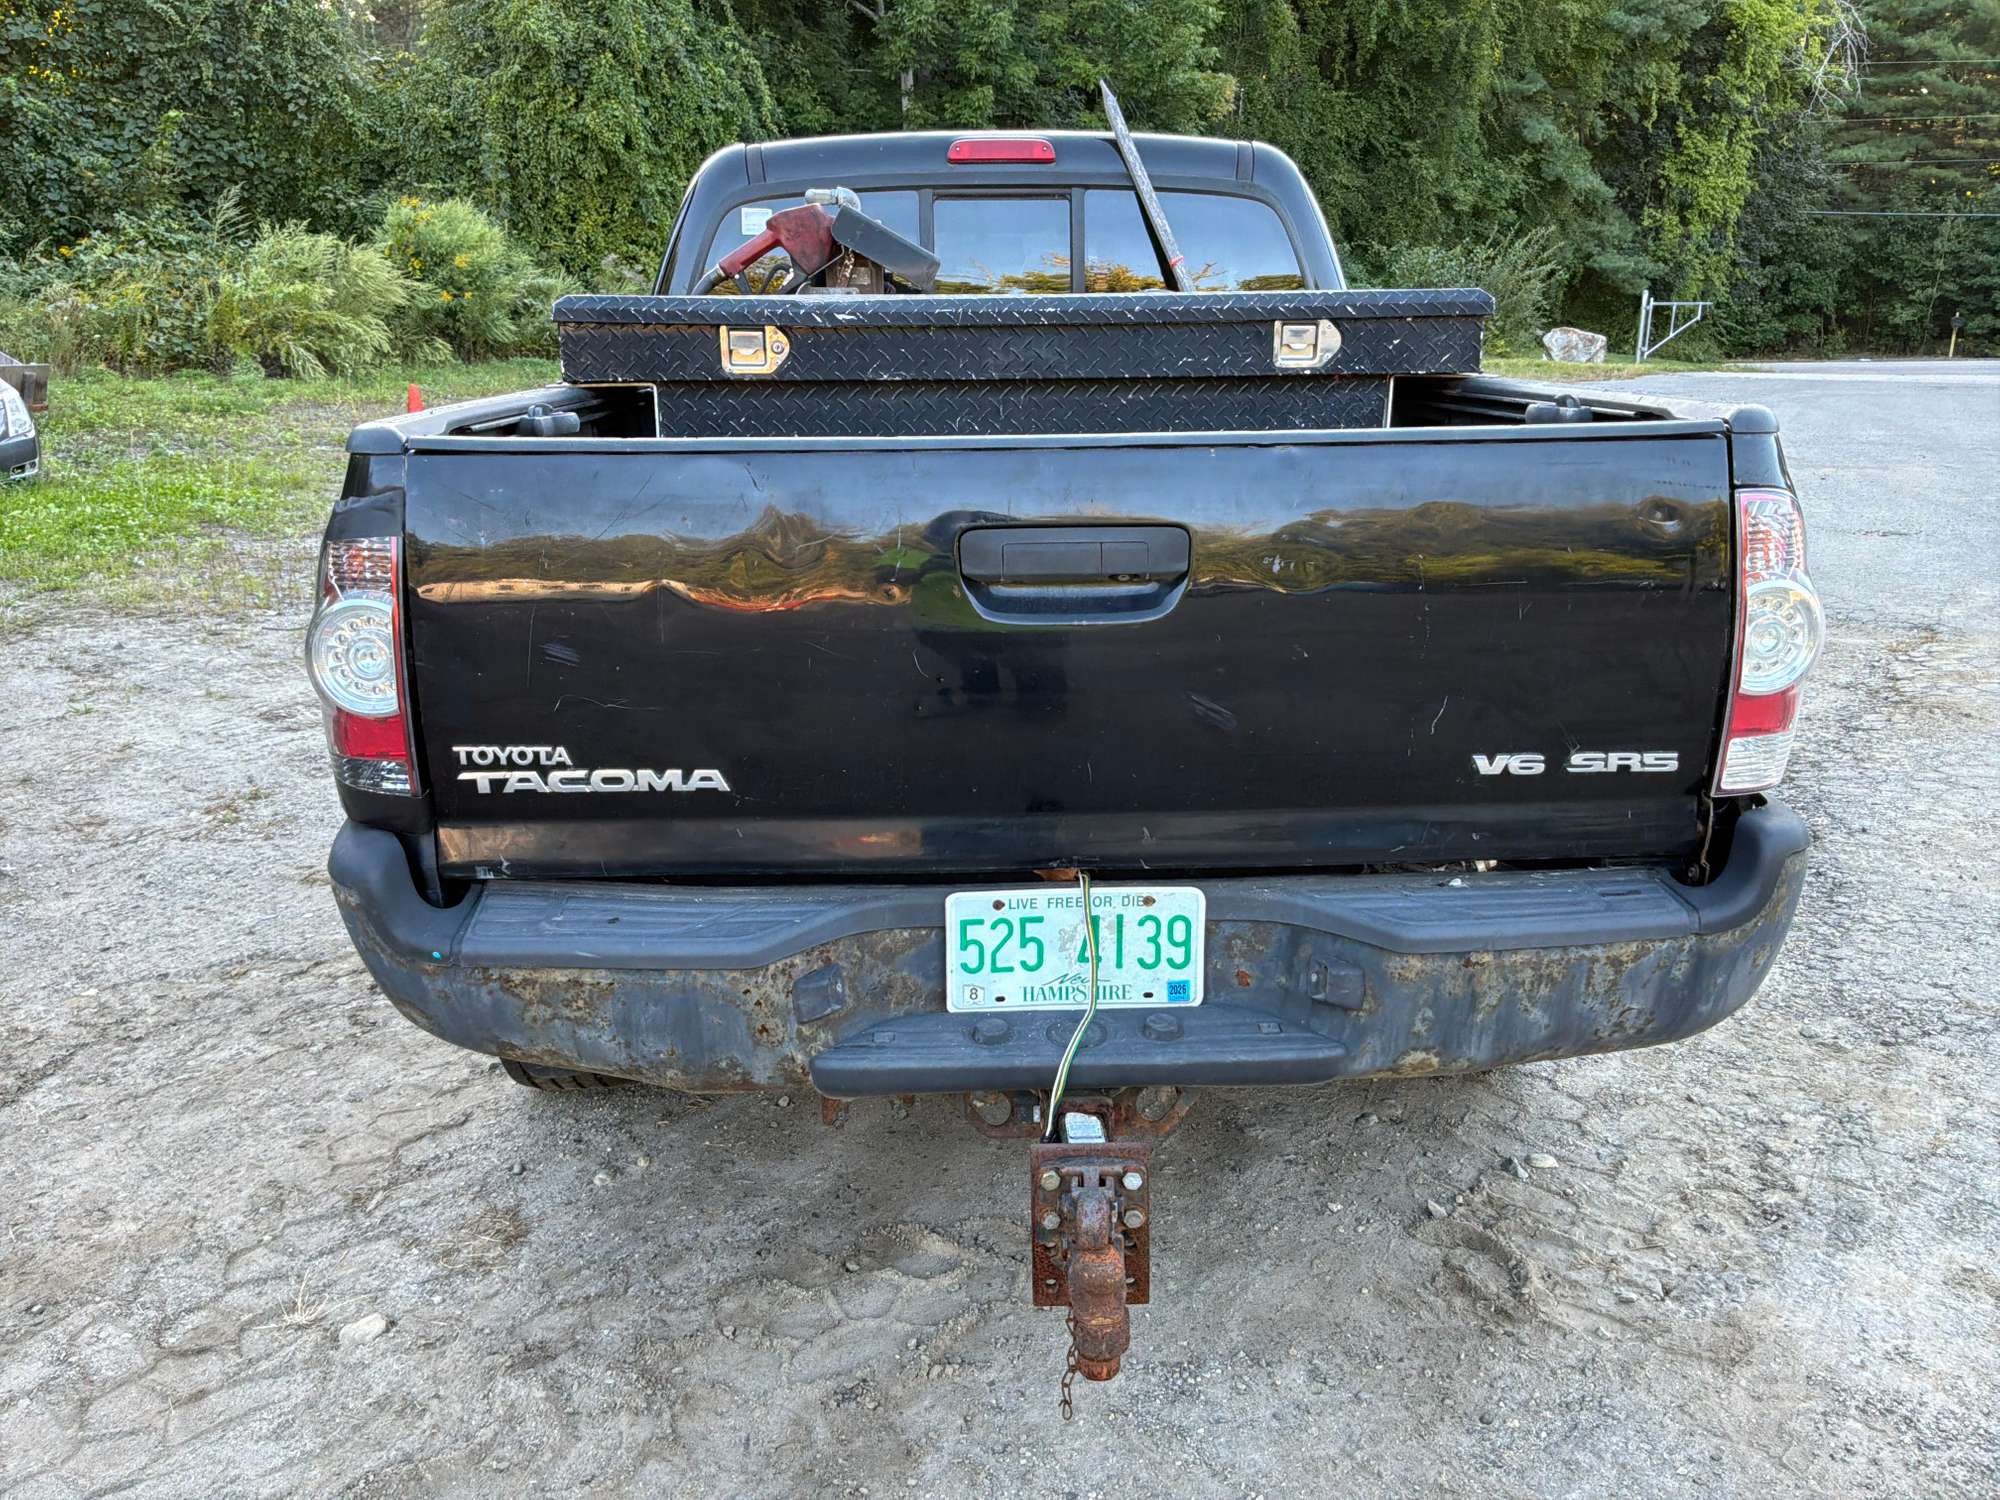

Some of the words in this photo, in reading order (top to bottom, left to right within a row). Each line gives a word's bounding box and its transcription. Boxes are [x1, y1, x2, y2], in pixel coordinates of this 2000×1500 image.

[452, 746, 573, 766] TOYOTA
[1472, 754, 1546, 776] V6
[1566, 752, 1679, 773] SR5
[456, 768, 731, 794] TACOMA
[1008, 897, 1038, 910] LIVE
[1047, 896, 1083, 909] FREE
[1092, 895, 1113, 908] OR
[959, 915, 1045, 974] 525
[1077, 913, 1192, 971] 4139
[968, 987, 978, 1001] 8
[1169, 985, 1187, 996] 2026
